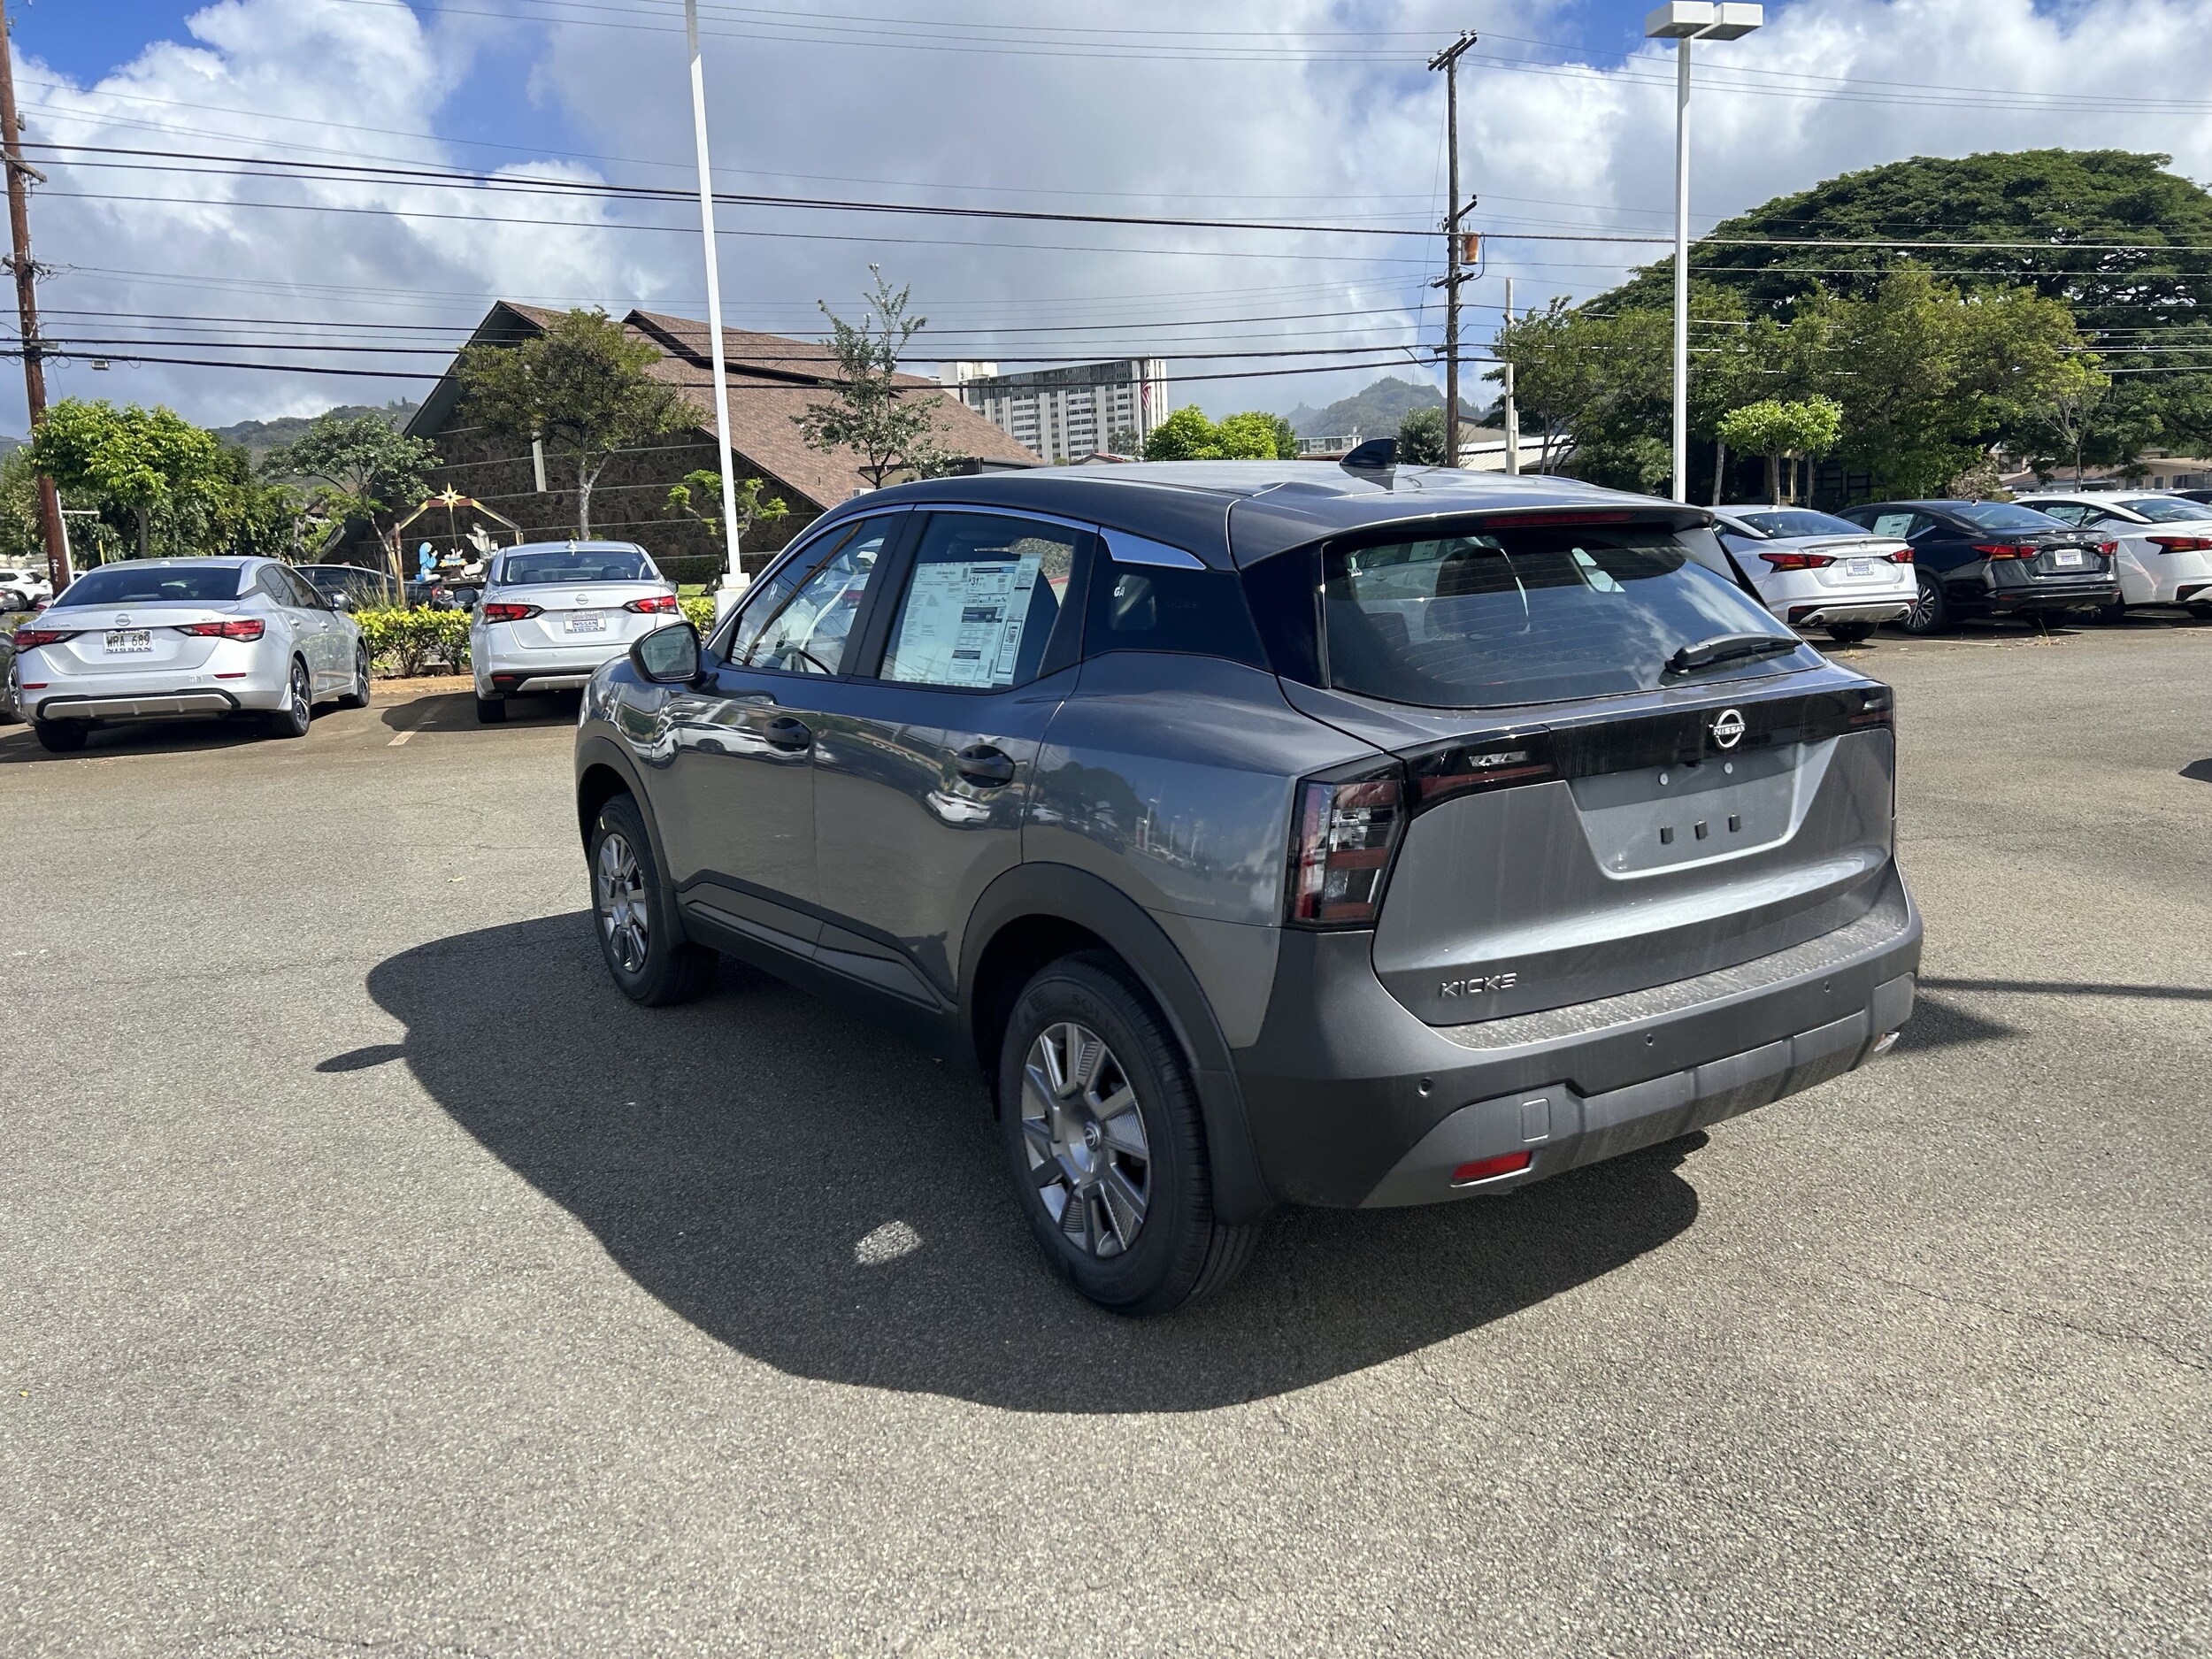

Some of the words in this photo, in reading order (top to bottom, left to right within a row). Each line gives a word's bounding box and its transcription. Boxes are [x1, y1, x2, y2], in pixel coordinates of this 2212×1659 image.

[971, 576, 979, 586] 31
[106, 635, 125, 648] WRA
[132, 634, 150, 646] 689
[1714, 725, 1745, 735] NISSAN
[1440, 972, 1517, 997] KICKS
